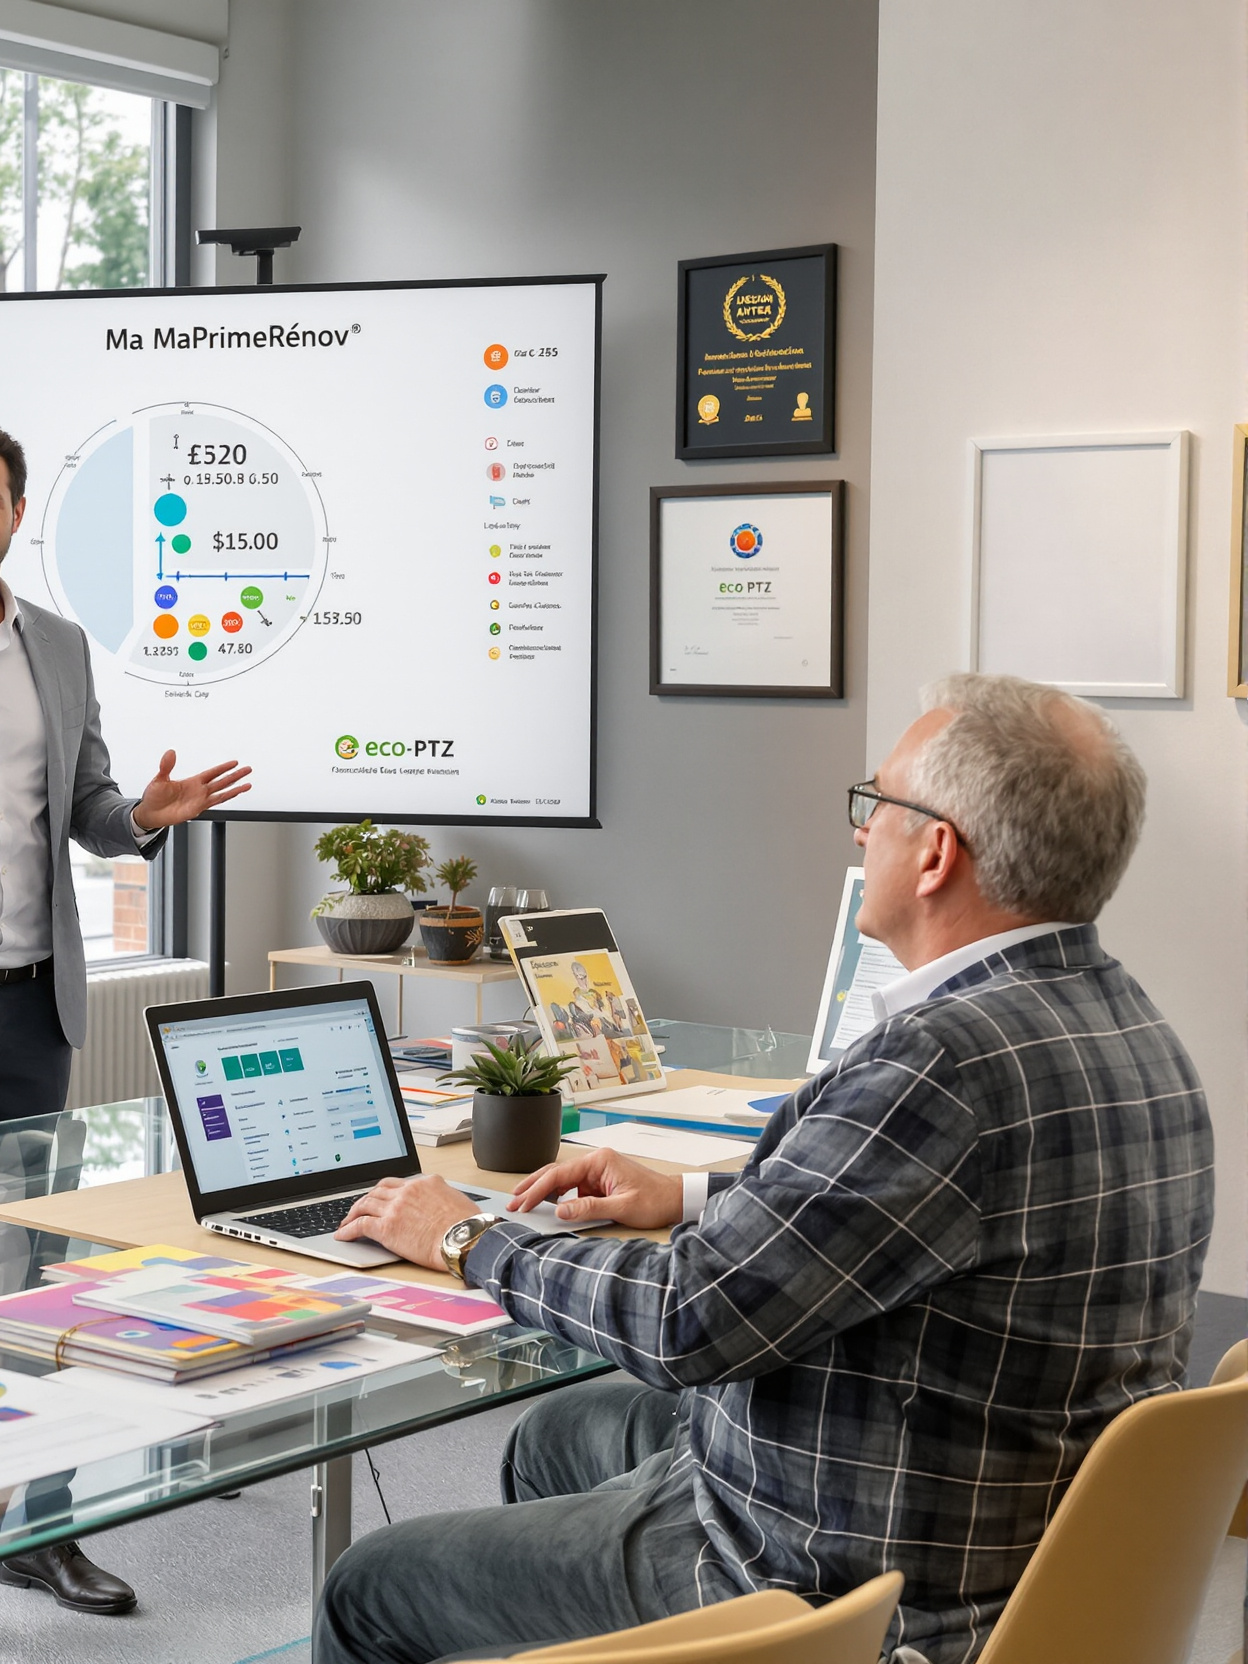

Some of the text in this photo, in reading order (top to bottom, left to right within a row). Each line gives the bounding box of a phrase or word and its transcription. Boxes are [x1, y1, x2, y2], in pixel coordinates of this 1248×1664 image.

[105, 328, 144, 350] Ma
[187, 444, 247, 465] £520
[212, 530, 279, 553] $15.00
[719, 581, 772, 593] eco PTZ
[364, 739, 455, 758] eco-PTZ
